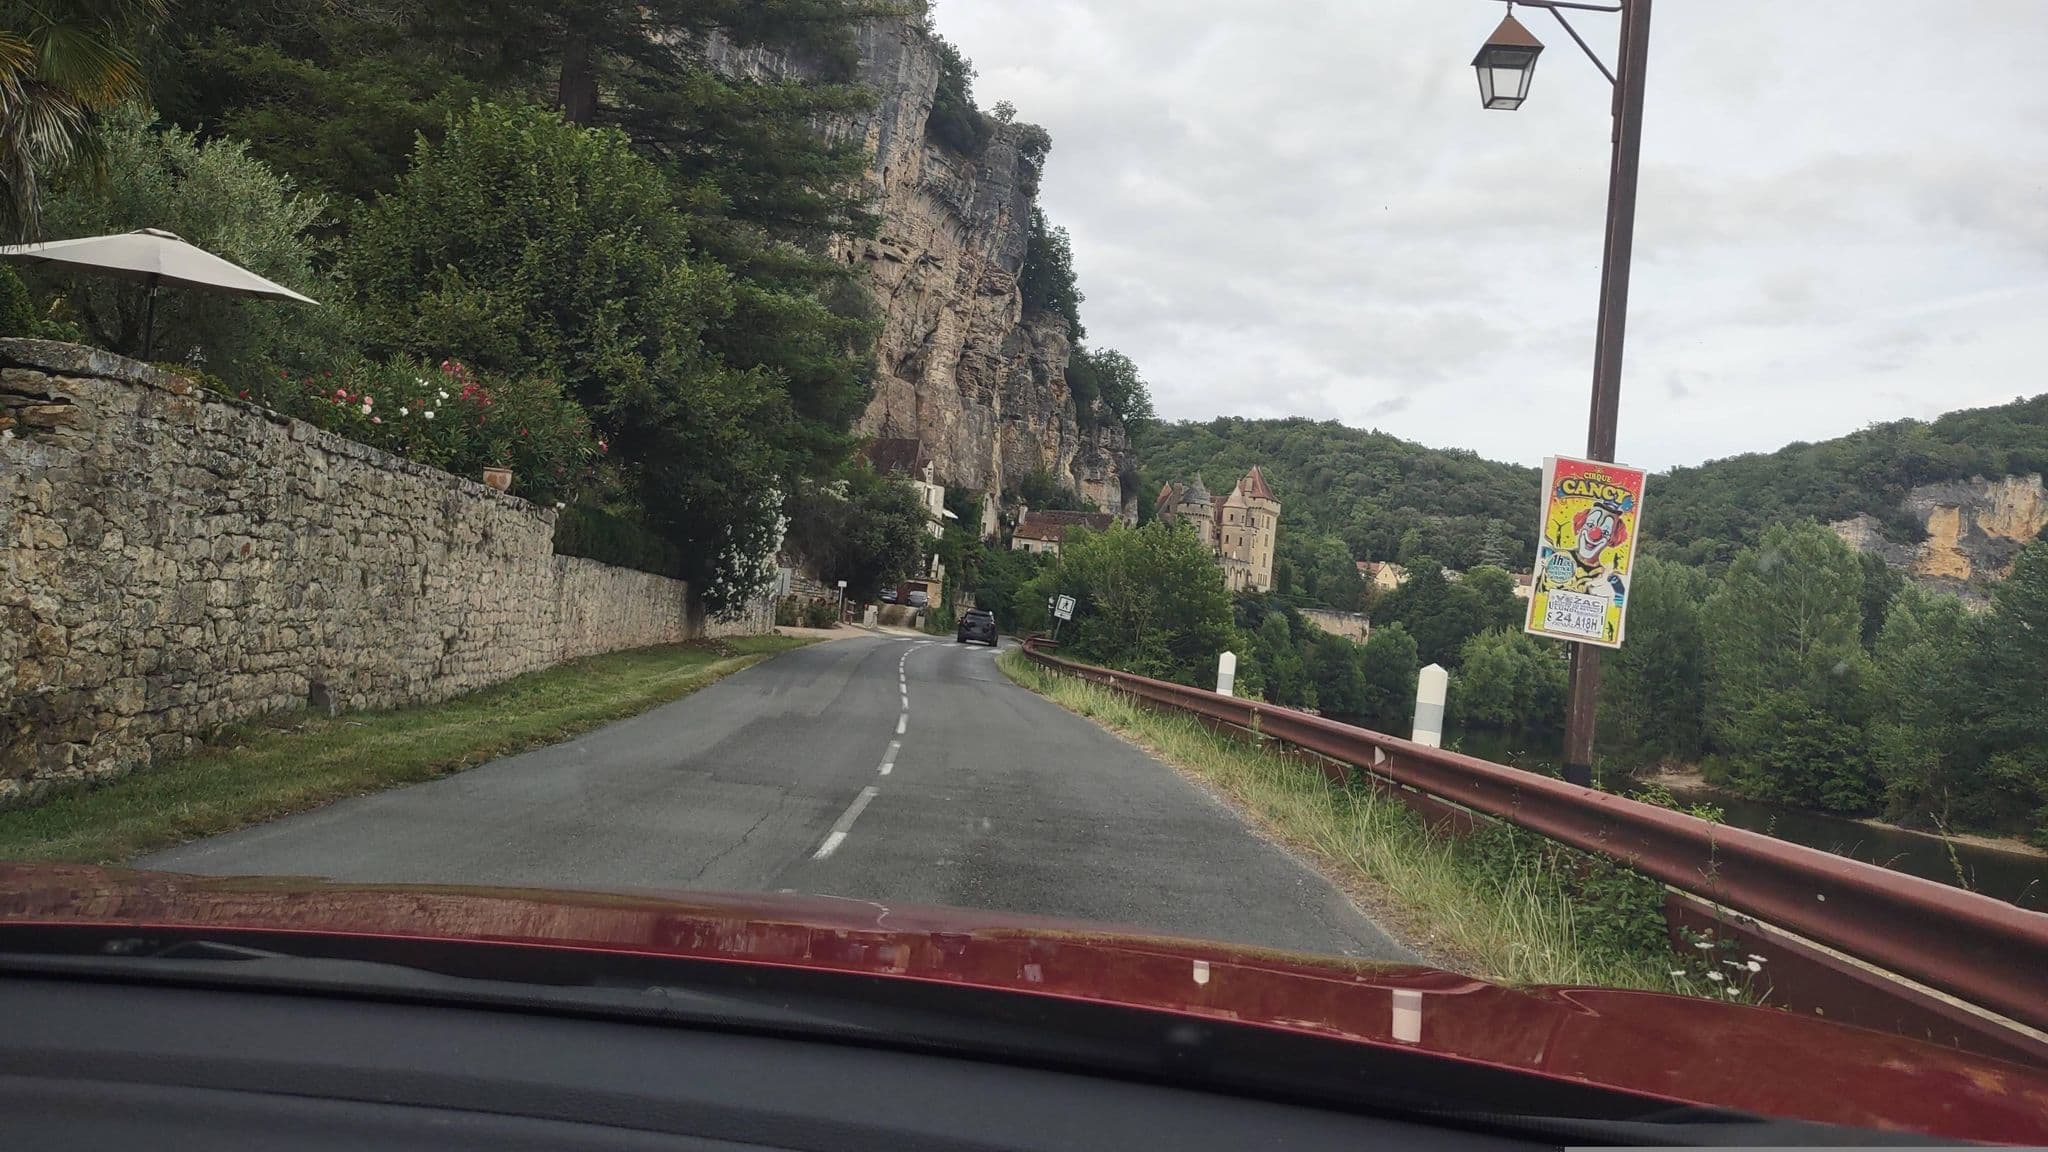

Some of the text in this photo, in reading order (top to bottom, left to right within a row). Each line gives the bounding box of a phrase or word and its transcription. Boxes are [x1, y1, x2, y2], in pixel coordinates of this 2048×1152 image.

[1583, 472, 1614, 483] CIRQUE
[1563, 479, 1630, 505] CANCY
[1555, 611, 1572, 623] 24
